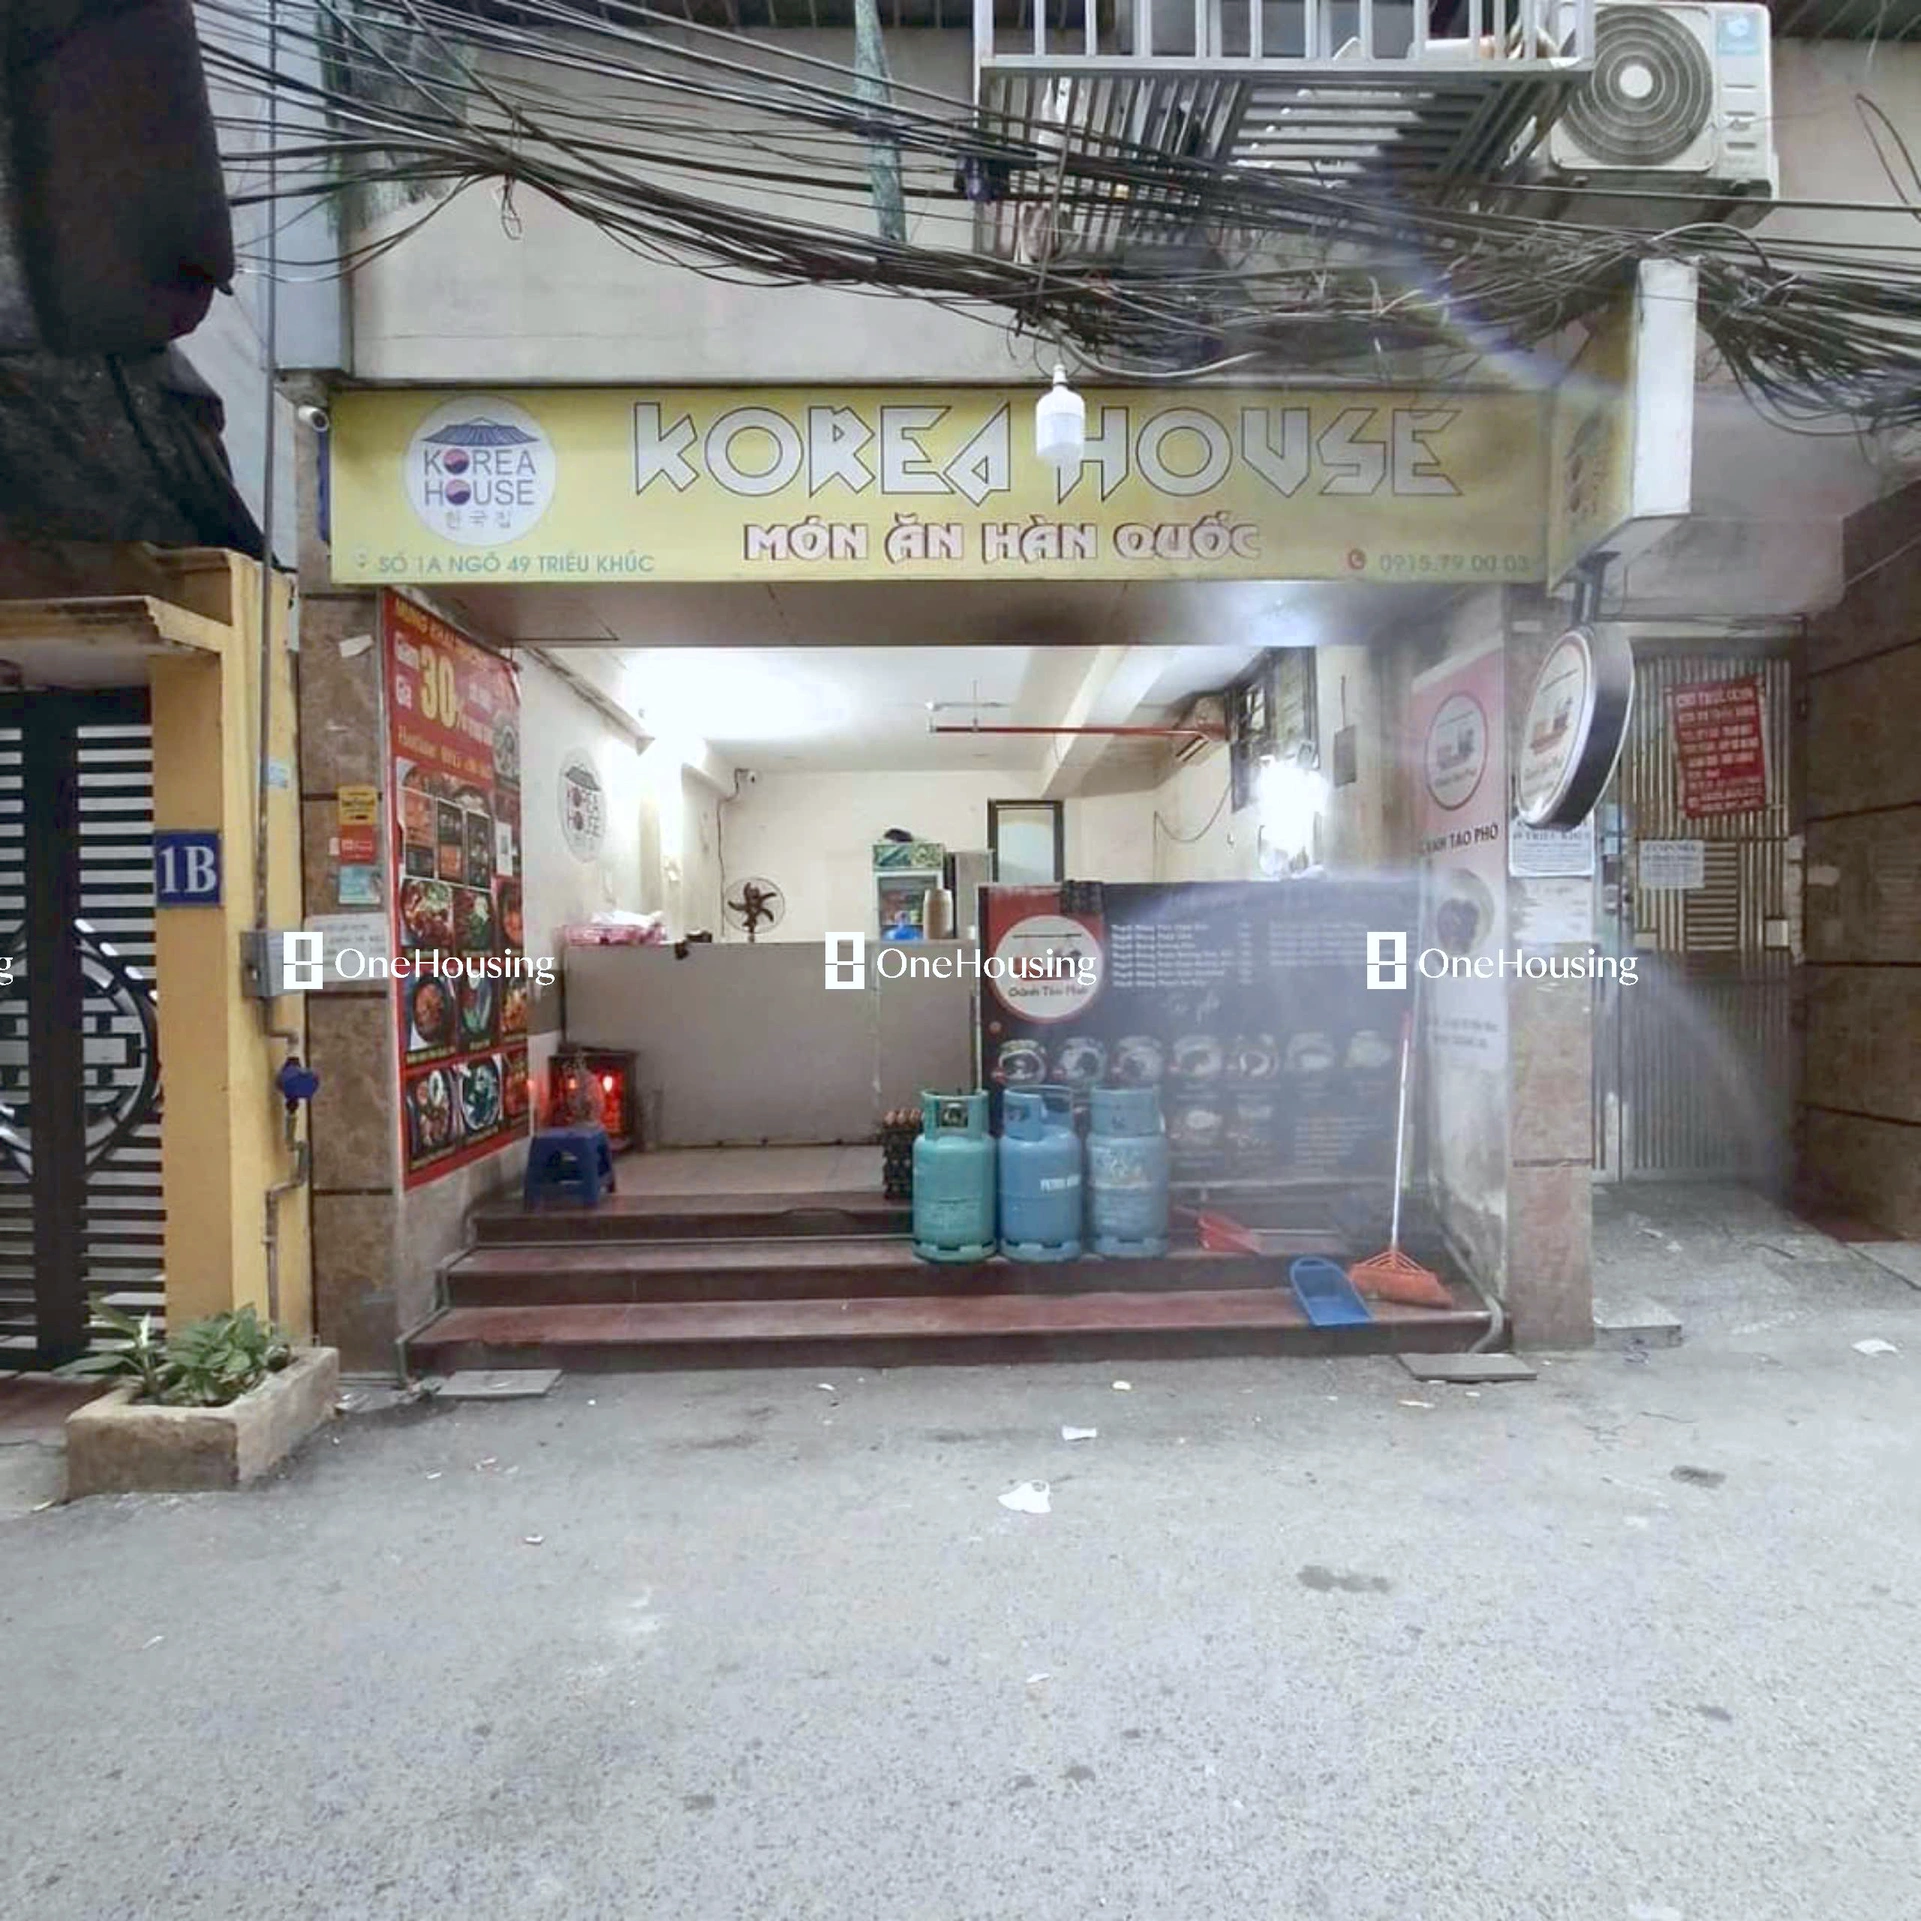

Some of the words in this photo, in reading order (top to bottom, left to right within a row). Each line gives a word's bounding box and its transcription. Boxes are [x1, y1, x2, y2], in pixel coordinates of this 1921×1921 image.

[423, 448, 537, 476] KOREA
[633, 401, 1011, 505] KOREA
[1058, 406, 1463, 504] HOUSE
[423, 479, 536, 506] HOUSE
[743, 514, 869, 561] MÓN
[885, 511, 965, 564] ĂN
[981, 514, 1098, 564] HÀN
[1112, 510, 1261, 561] QUỐC
[506, 555, 531, 574] 49
[420, 643, 458, 729] 30
[160, 845, 217, 894] 1B
